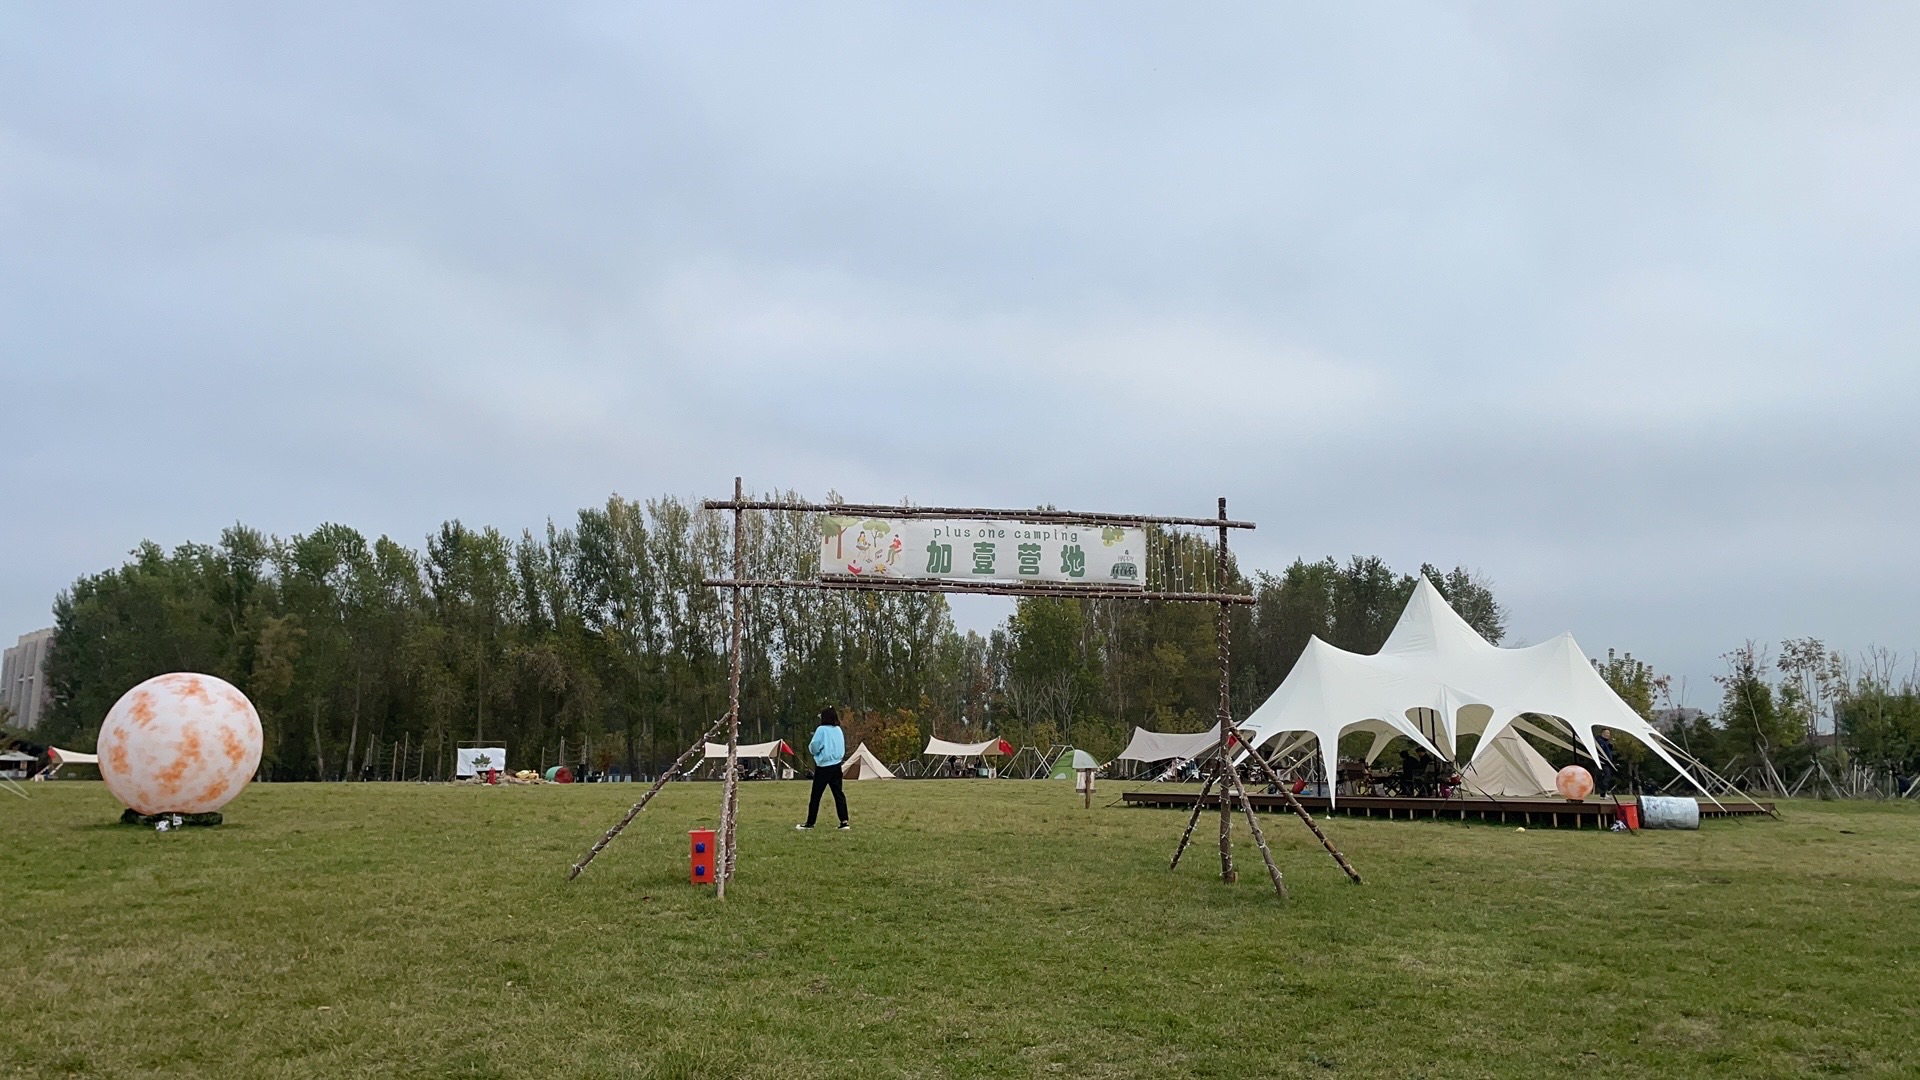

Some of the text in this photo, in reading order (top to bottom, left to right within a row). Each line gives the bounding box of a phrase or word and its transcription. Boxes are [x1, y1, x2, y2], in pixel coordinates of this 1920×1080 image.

[934, 526, 1078, 543] plus one camping
[926, 540, 1085, 577] 加壹营地
